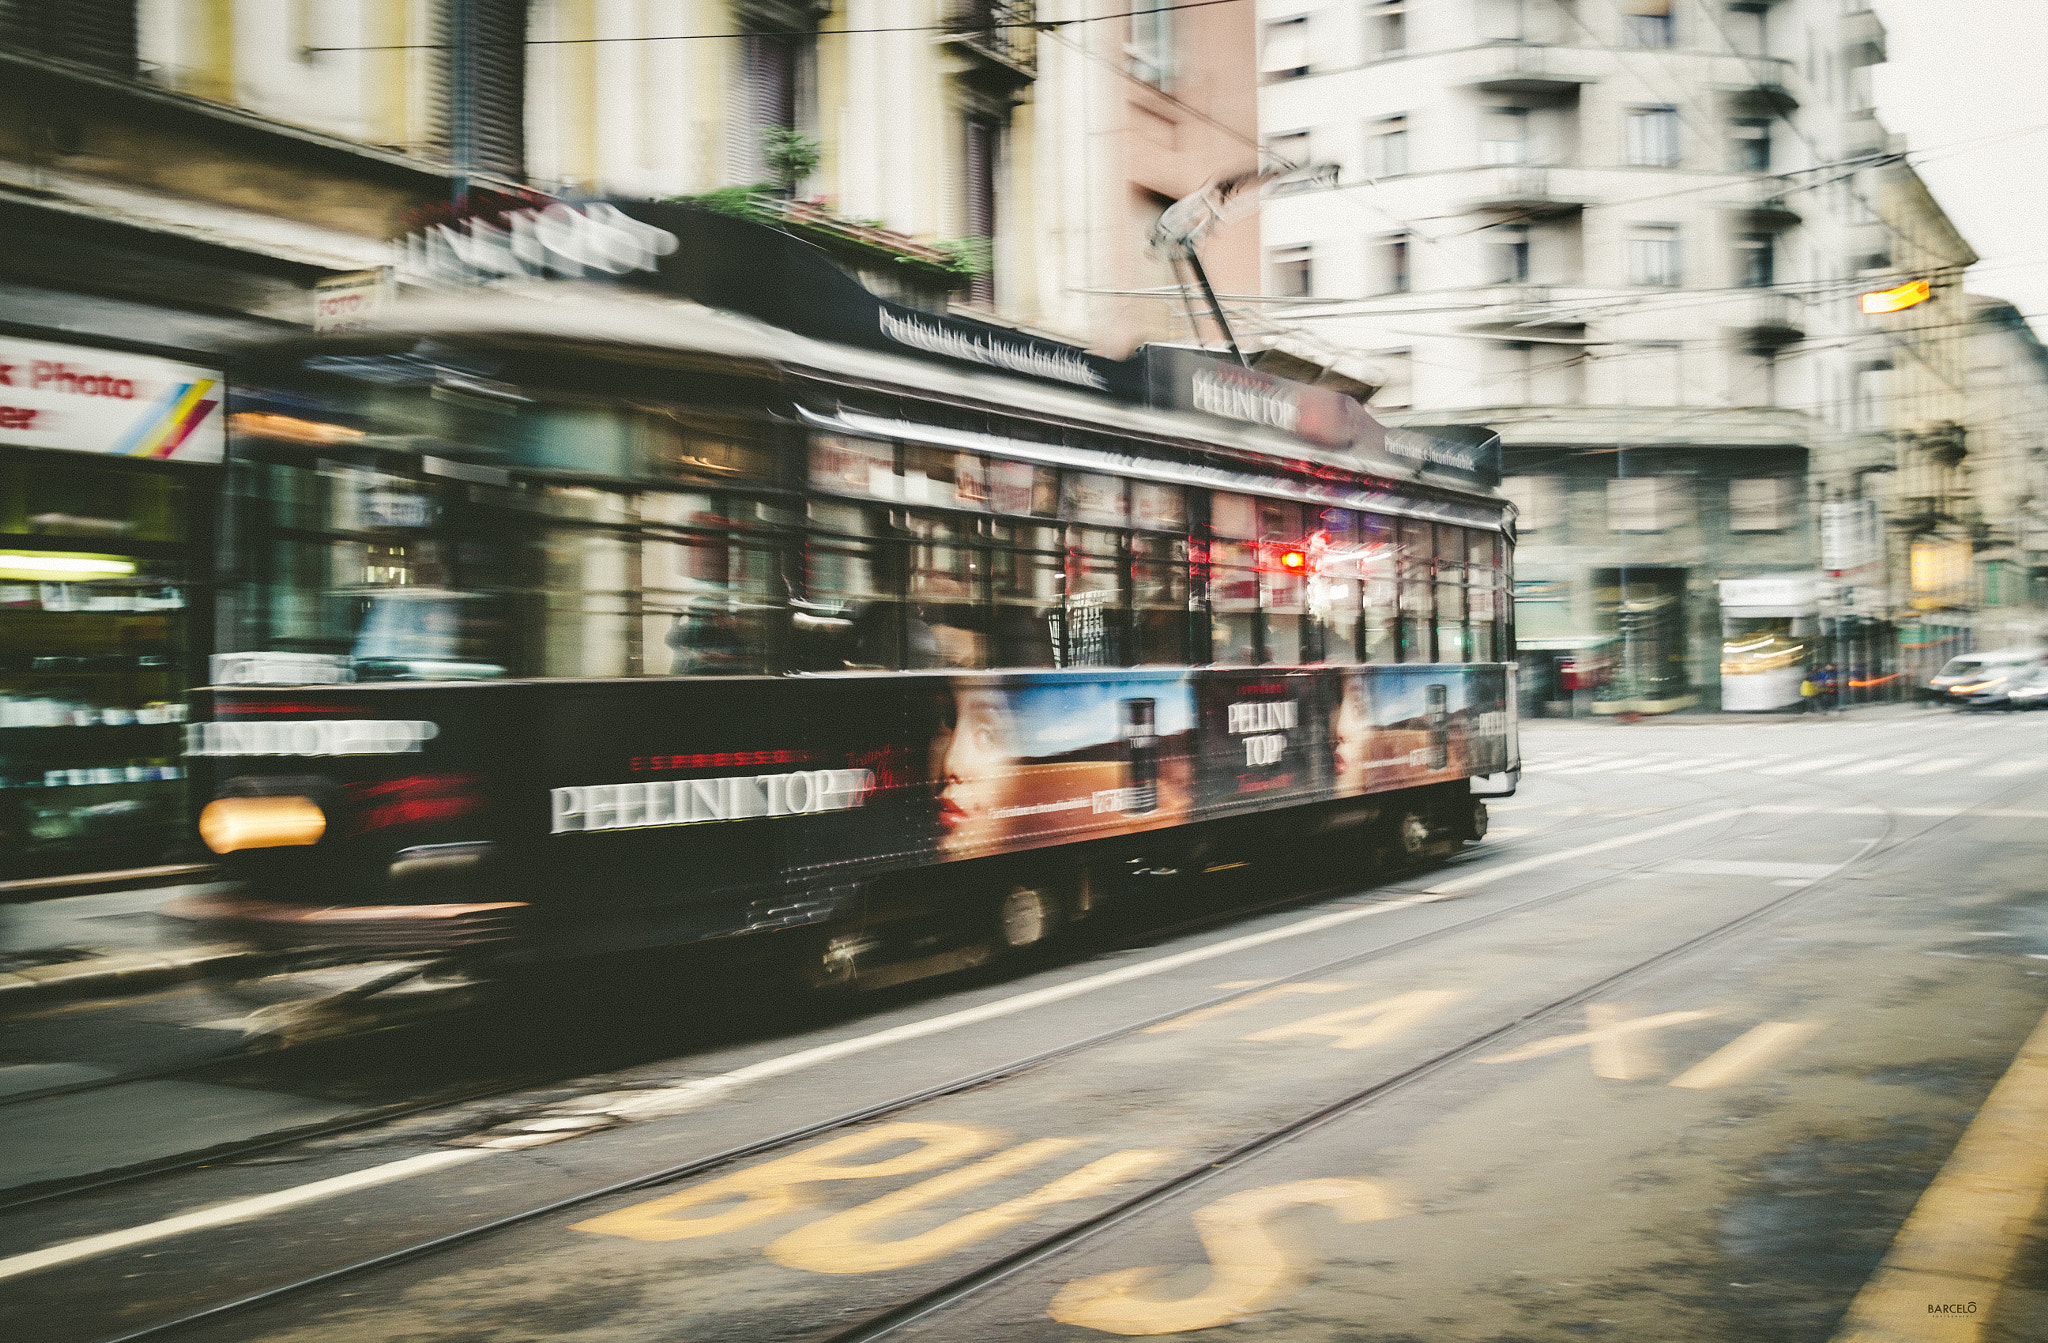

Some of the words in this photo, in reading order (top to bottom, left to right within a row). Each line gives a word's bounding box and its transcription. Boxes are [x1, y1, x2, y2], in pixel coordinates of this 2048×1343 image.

[30, 359, 135, 399] Photo
[1242, 735, 1287, 767] TOP
[754, 768, 856, 818] TOP
[566, 1120, 1398, 1336] BUS
